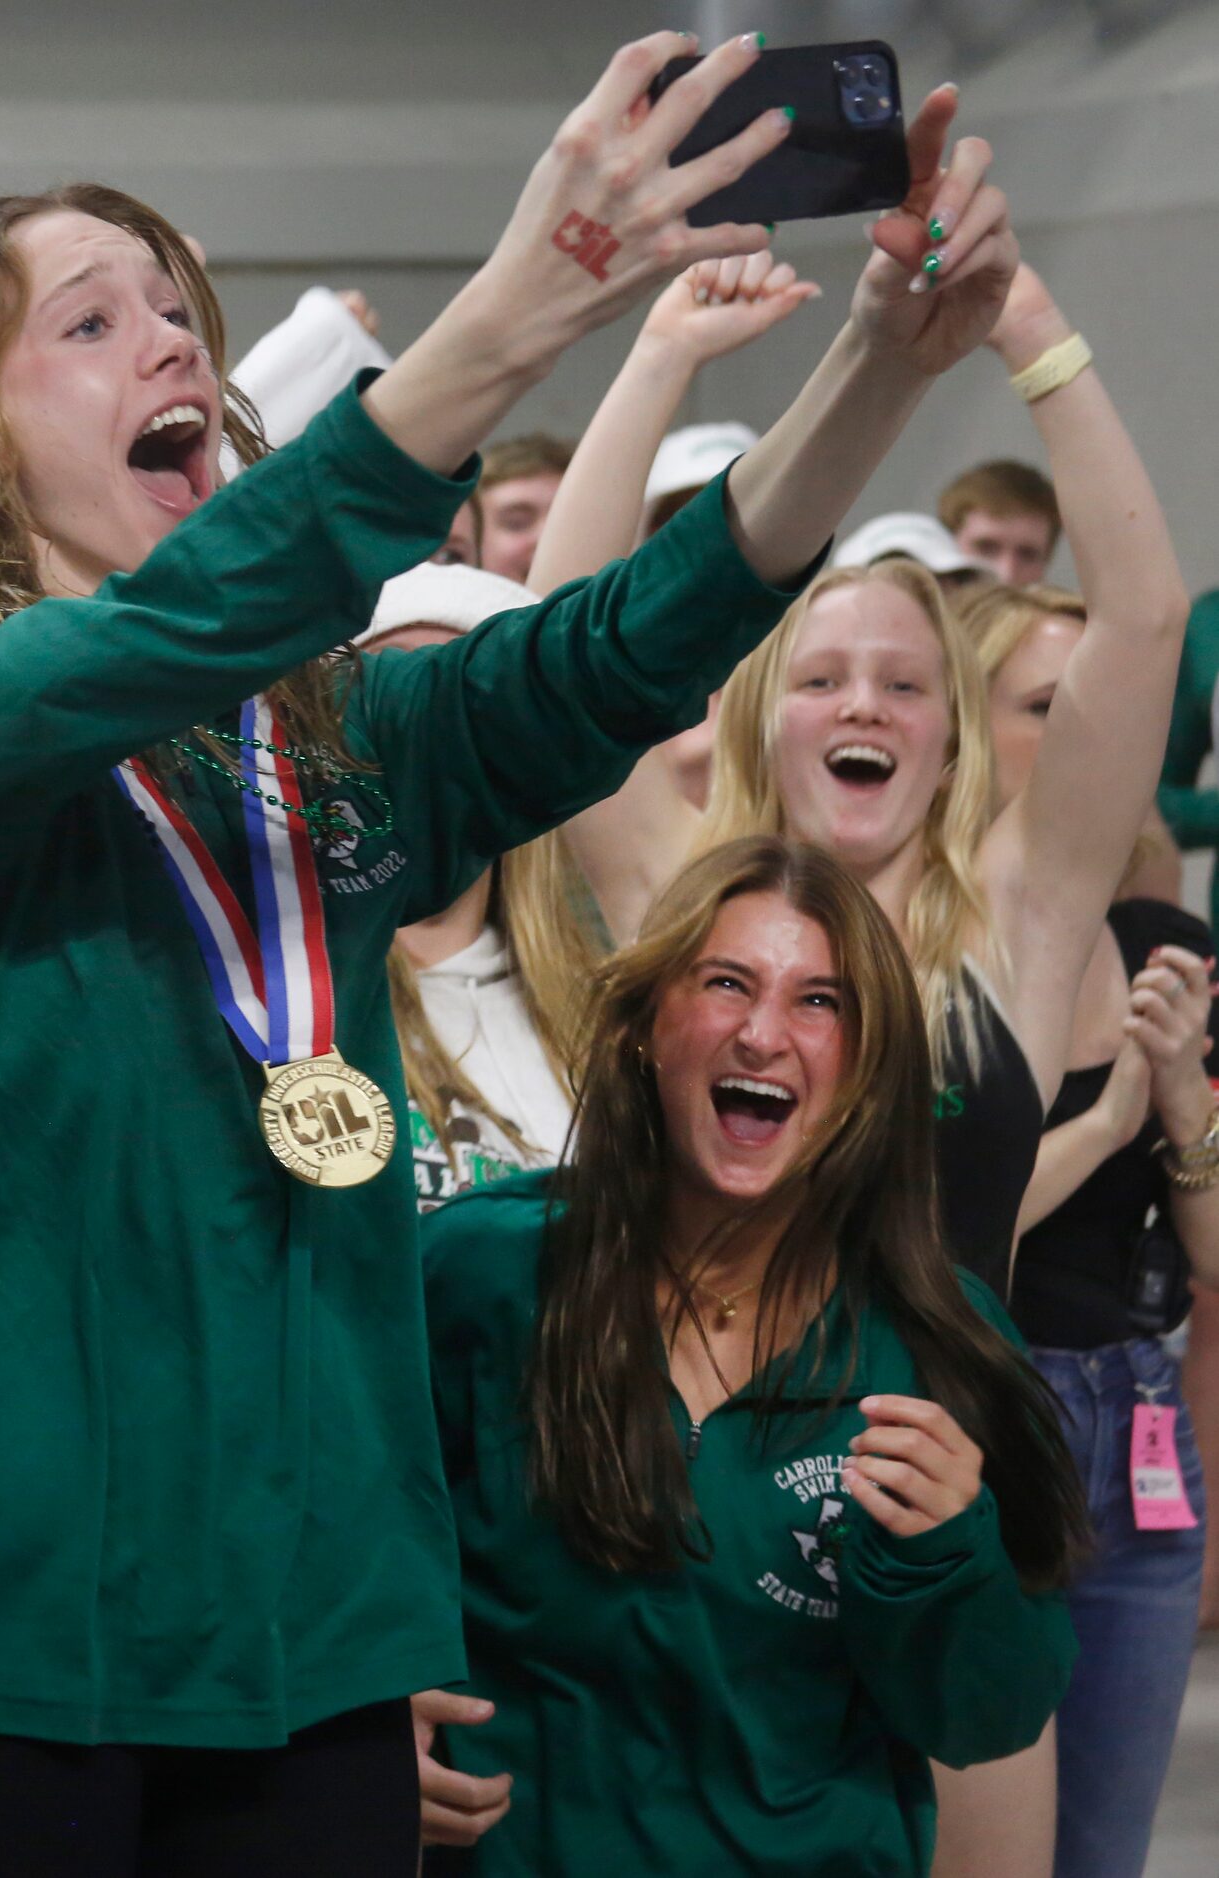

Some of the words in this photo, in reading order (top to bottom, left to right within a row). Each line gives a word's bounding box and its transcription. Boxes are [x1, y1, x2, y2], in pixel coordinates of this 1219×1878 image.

[329, 874, 373, 894] TEAM
[369, 850, 407, 885] 2022
[314, 1137, 364, 1160] STATE
[794, 1474, 836, 1504] SWIM
[756, 1571, 806, 1613] STATE
